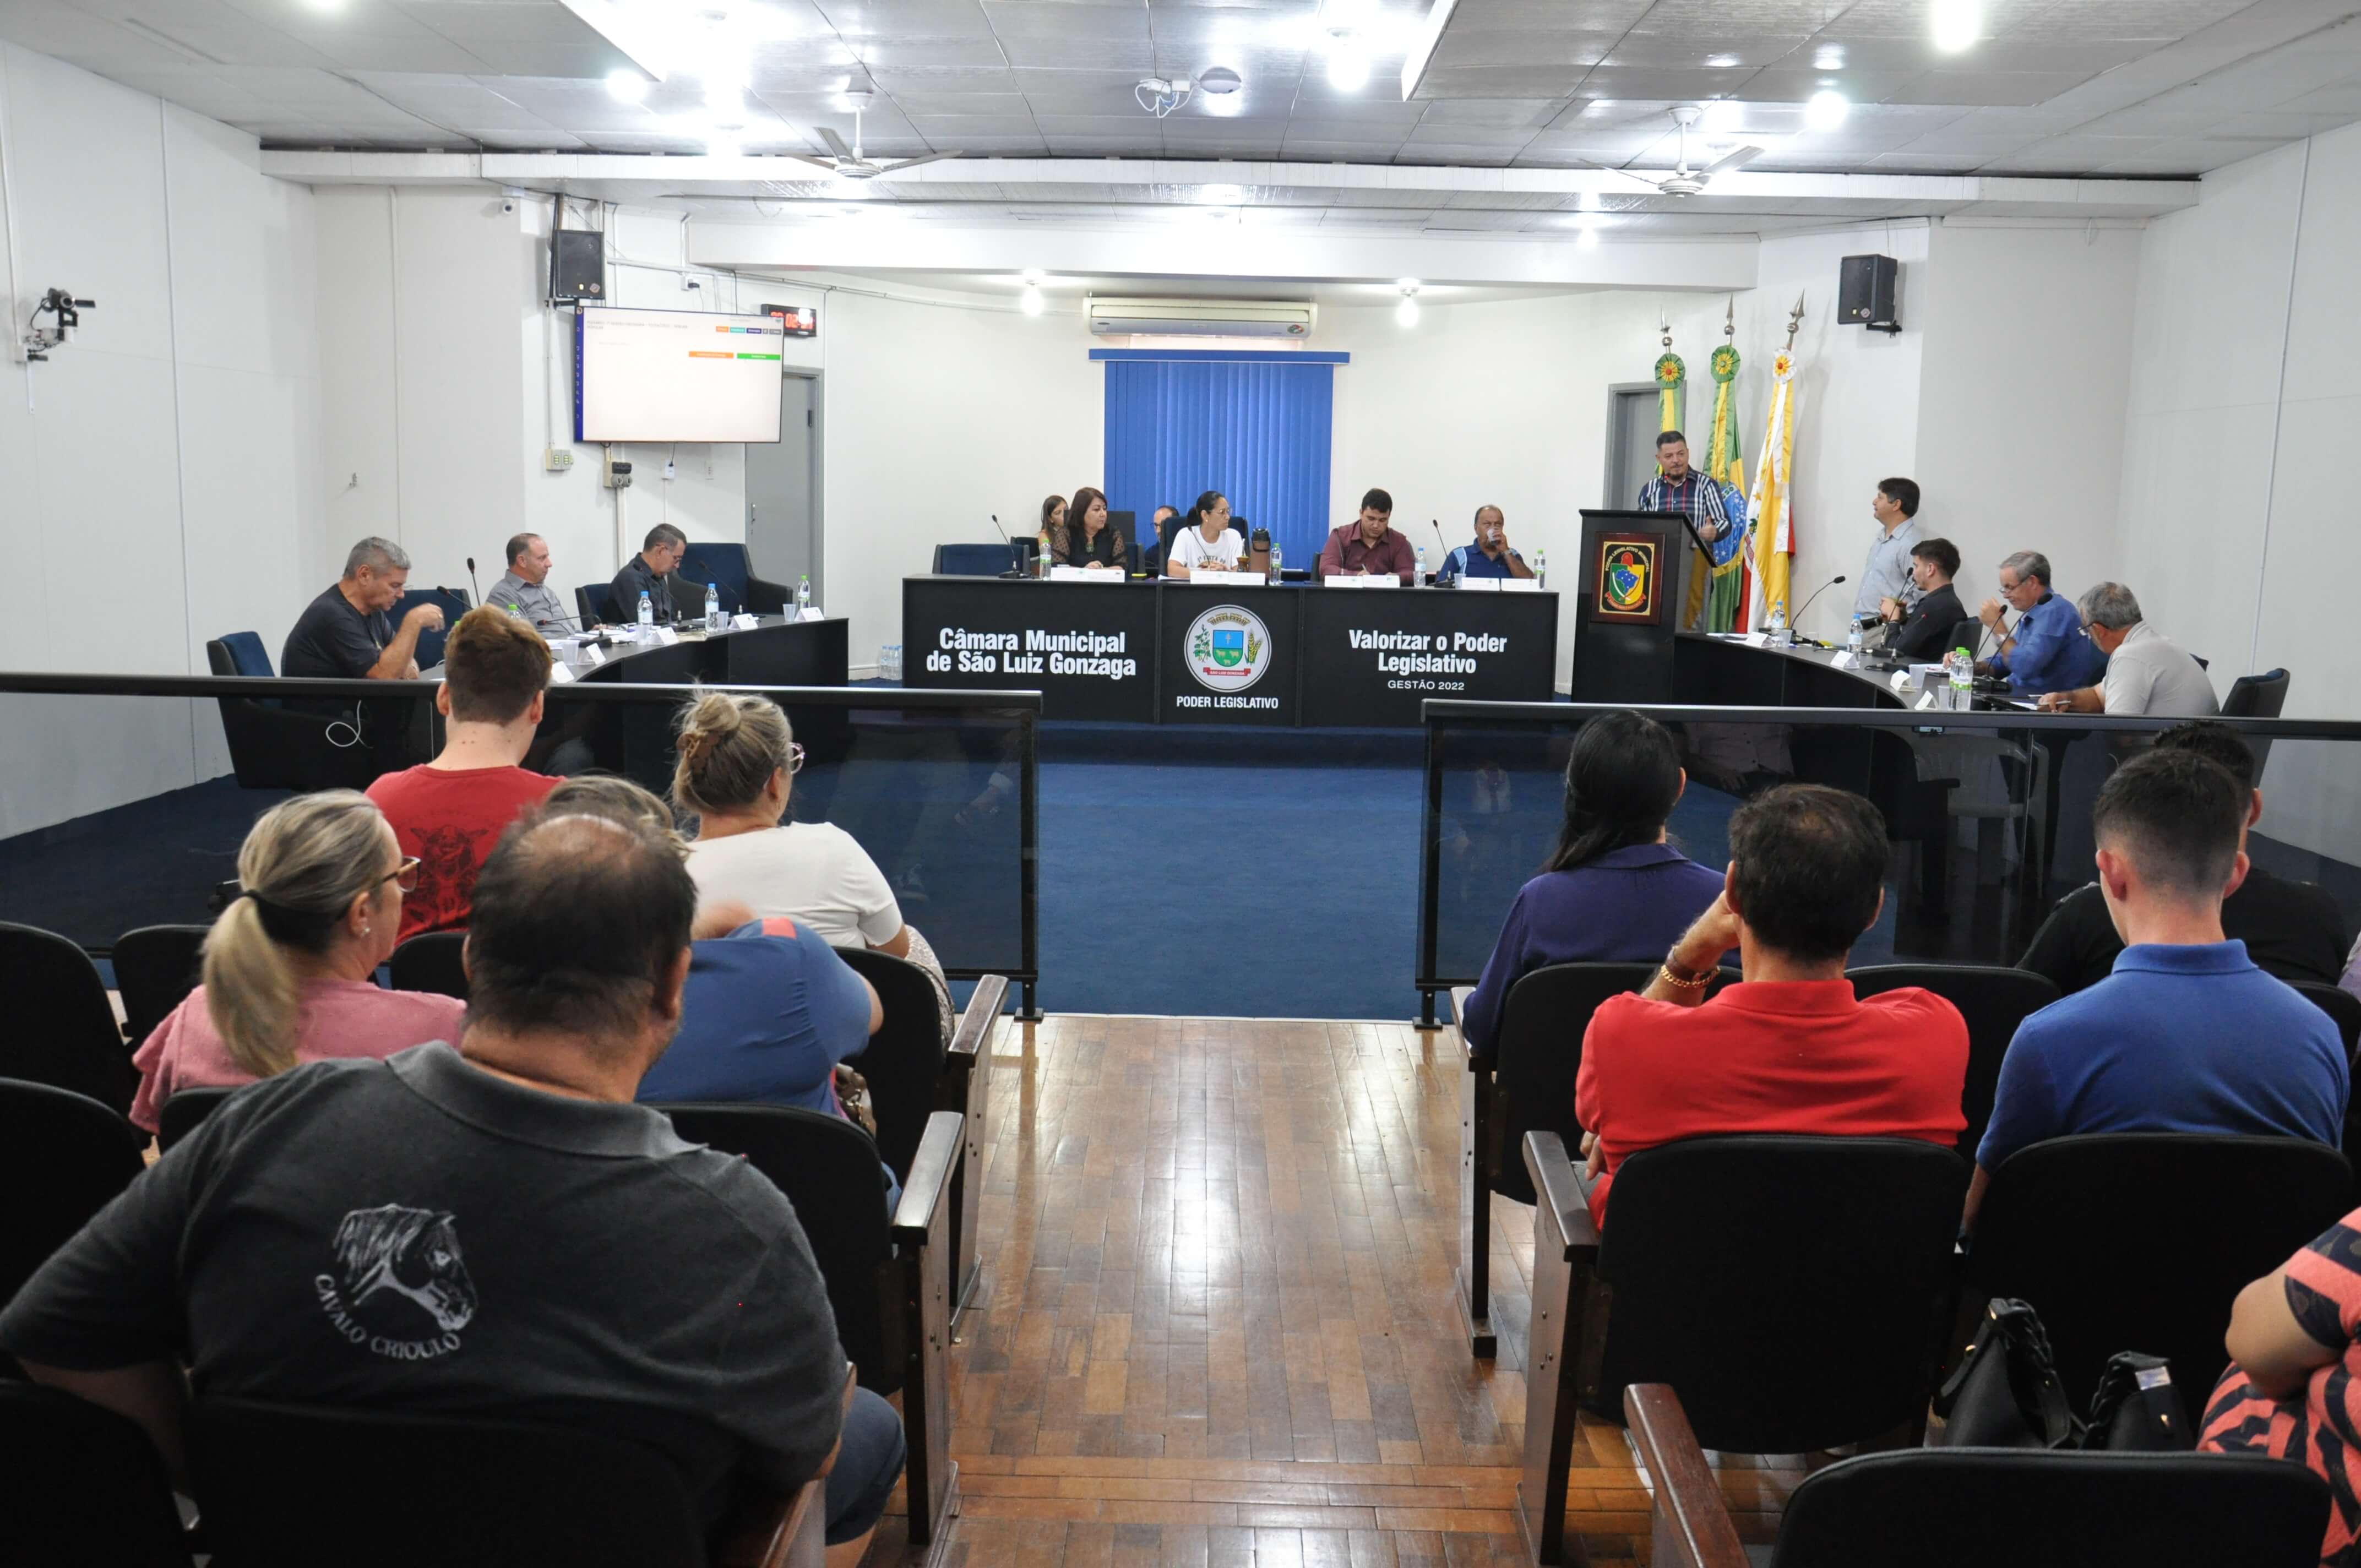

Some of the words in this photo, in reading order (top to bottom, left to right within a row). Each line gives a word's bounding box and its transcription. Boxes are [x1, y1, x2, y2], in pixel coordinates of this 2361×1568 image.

[939, 628, 1018, 650] Câmara
[1025, 630, 1125, 656] Municipal
[1349, 629, 1430, 650] Valorizar
[1436, 635, 1448, 651] o
[1454, 632, 1508, 652] Poder
[926, 650, 951, 672] de
[958, 651, 996, 672] São
[1004, 652, 1043, 673] Luiz
[1049, 652, 1136, 680] Gonzaga
[1378, 652, 1476, 676] Legislativo
[1388, 679, 1435, 689] GESTÃO
[1438, 682, 1465, 690] 2022
[1176, 696, 1211, 707] PODER
[1214, 696, 1279, 709] LEGISLATIVO
[314, 1274, 366, 1343] CAVALO
[371, 1332, 461, 1360] CRIOULO
